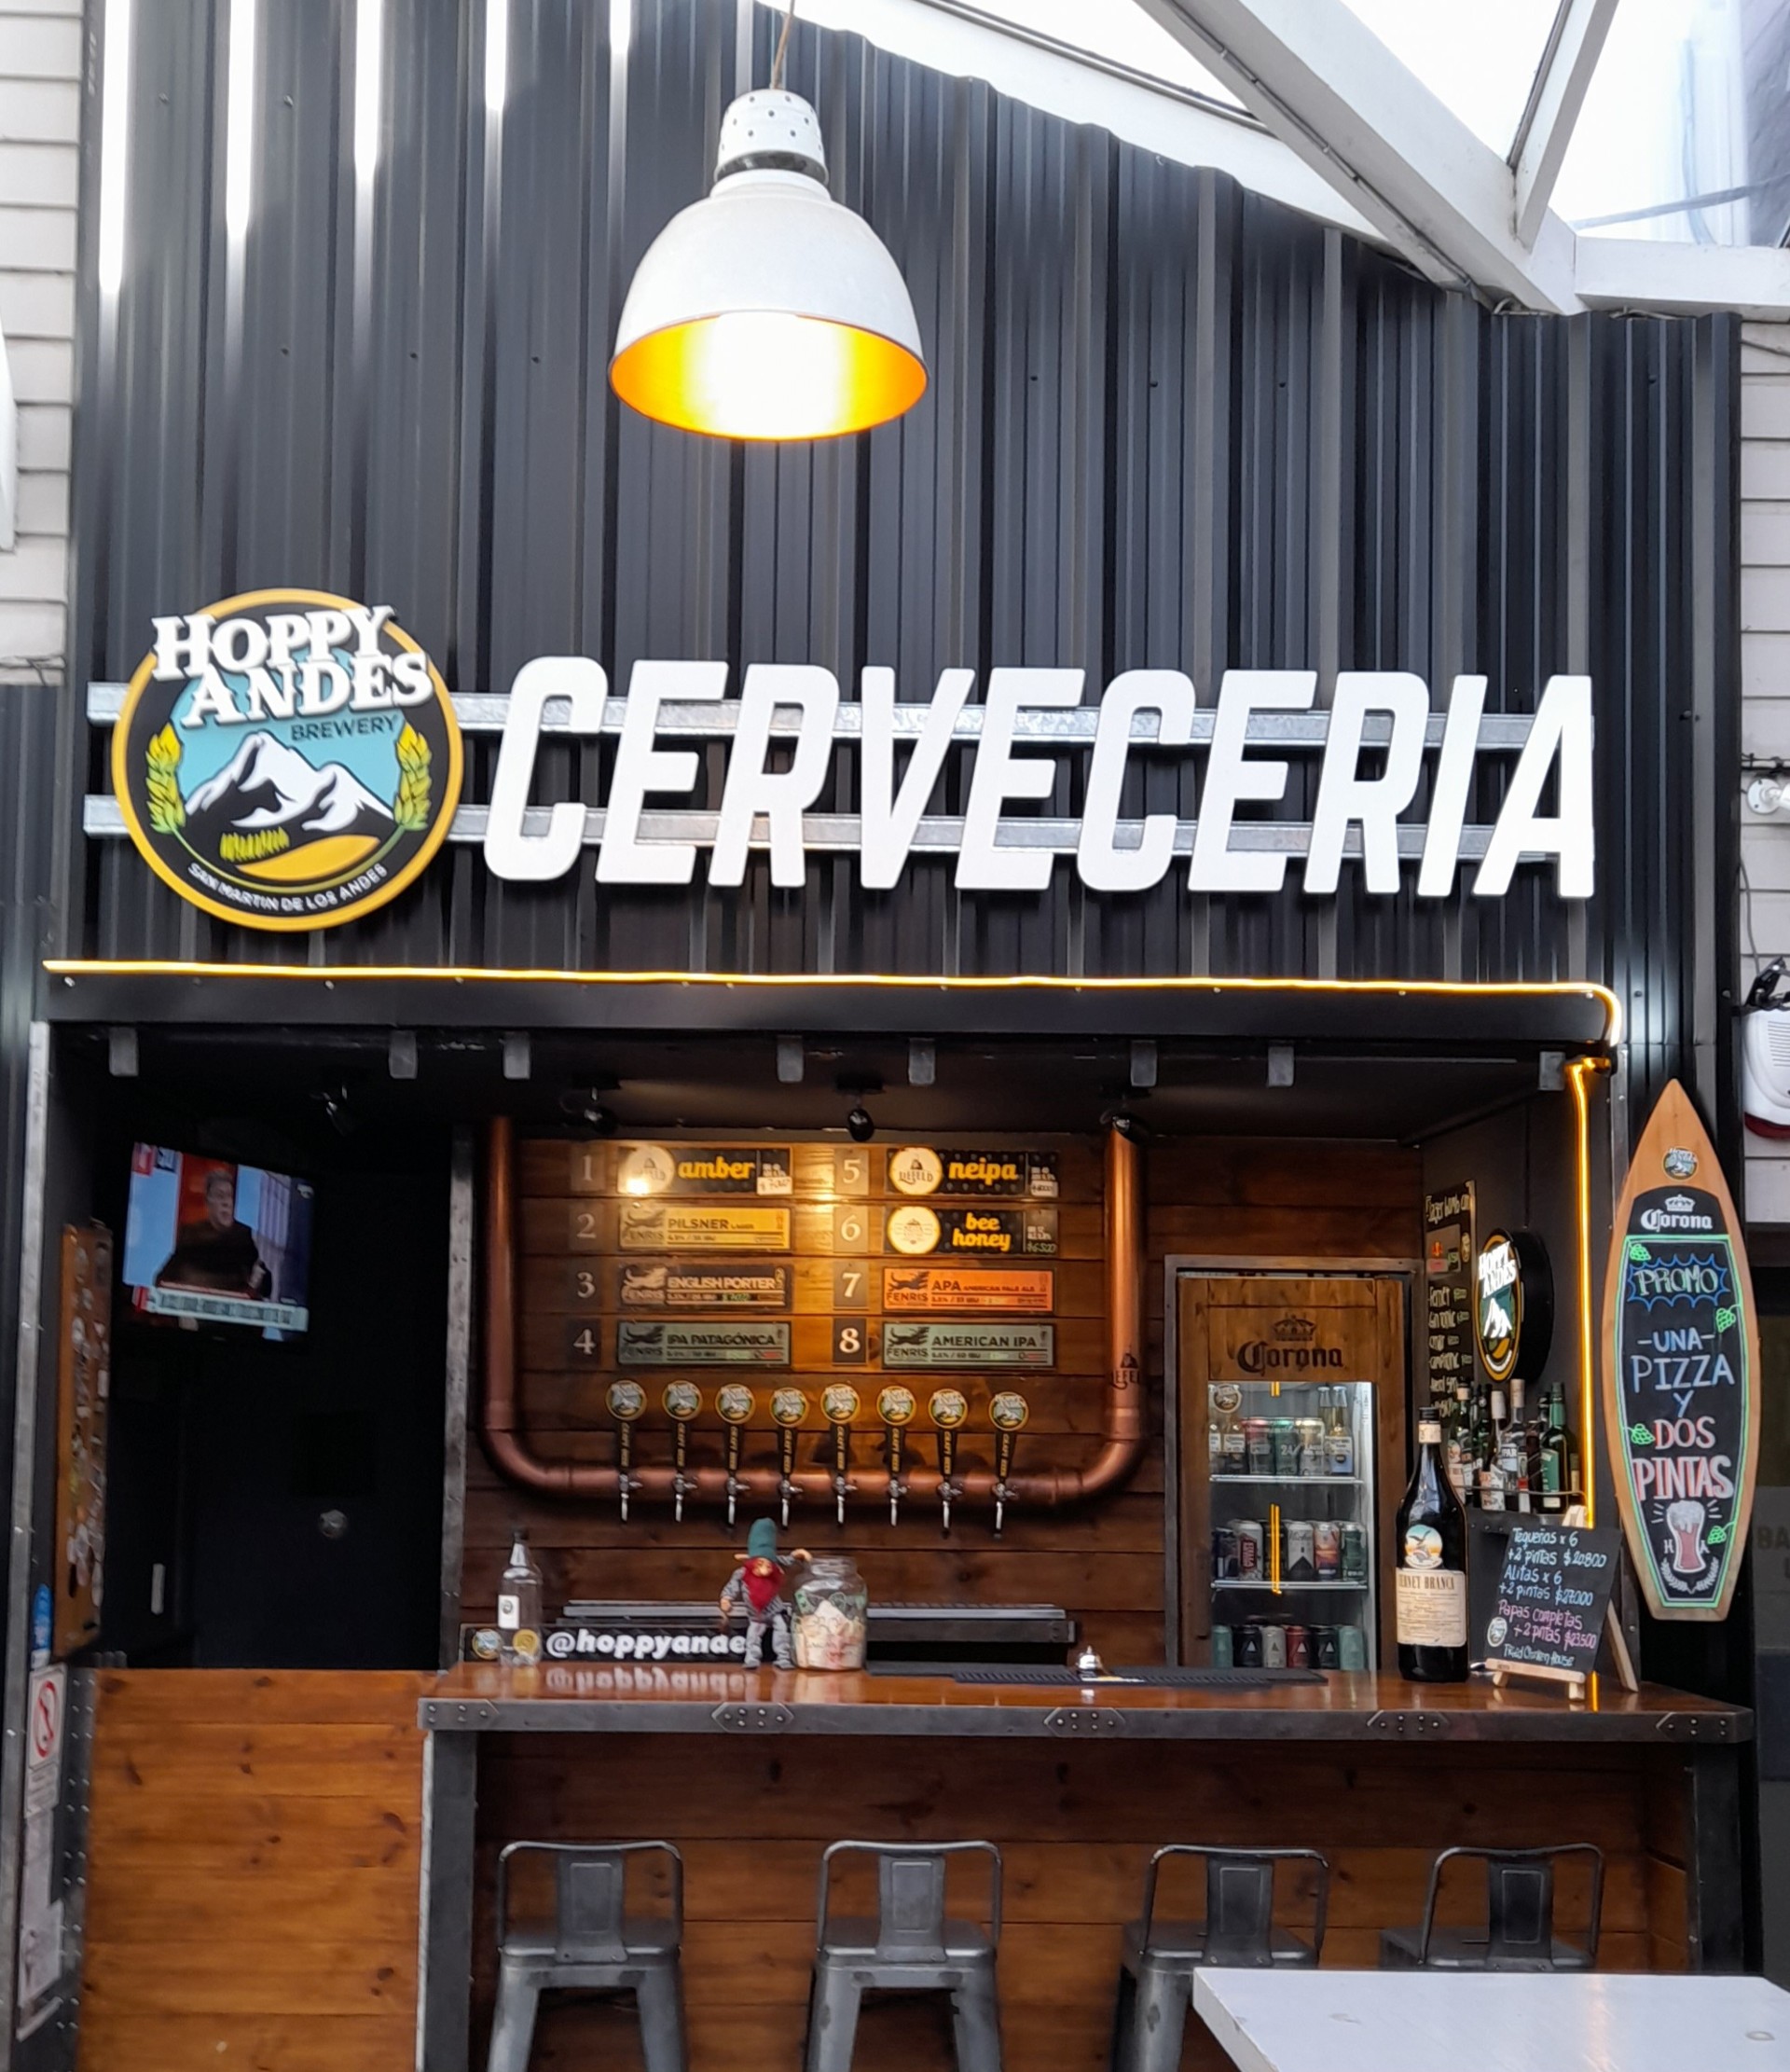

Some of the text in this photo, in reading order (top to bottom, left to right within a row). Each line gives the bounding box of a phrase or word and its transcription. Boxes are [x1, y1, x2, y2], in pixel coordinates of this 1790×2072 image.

[151, 604, 397, 682] HOPPY
[180, 653, 434, 727] ANDES
[291, 715, 398, 741] BREWERY
[483, 656, 1593, 897] CERVECERIA
[187, 862, 387, 912] SAN MARTIN DE LOS ANDES
[581, 1154, 593, 1181] 1
[678, 1156, 755, 1180] amber
[843, 1159, 861, 1184] 5
[948, 1157, 1017, 1185] neipa
[576, 1213, 596, 1238] 2
[668, 1219, 729, 1230] PILSNER
[841, 1215, 861, 1241] 6
[965, 1212, 1000, 1231] bee
[1641, 1209, 1714, 1232] Corona
[952, 1228, 1012, 1252] honey
[576, 1272, 596, 1298] 3
[668, 1277, 776, 1290] ENGLISH PORTER
[842, 1272, 861, 1298] 7
[932, 1280, 961, 1292] APA
[1633, 1264, 1718, 1296] PROMO
[887, 1292, 928, 1302] FENRIS
[572, 1329, 596, 1355] 4
[667, 1332, 776, 1345] IPA PATAGÓNICA
[839, 1327, 861, 1353] 8
[932, 1335, 1037, 1347] AMERICAN IPA
[887, 1347, 928, 1358] FENRIS
[1236, 1340, 1344, 1376] Corona
[1631, 1354, 1735, 1393] PIZZA
[1673, 1390, 1694, 1417] Y
[1654, 1416, 1715, 1450] DOS
[1632, 1455, 1735, 1501] PINTAS
[1512, 1527, 1557, 1549] Tequeños
[1568, 1531, 1578, 1547] 6
[1525, 1549, 1557, 1566] pintas
[1425, 1576, 1454, 1590] BRANCA
[1504, 1564, 1539, 1582] Alitas
[1553, 1570, 1563, 1585] 6
[1516, 1584, 1550, 1601] pintas
[1498, 1599, 1530, 1623] Papas
